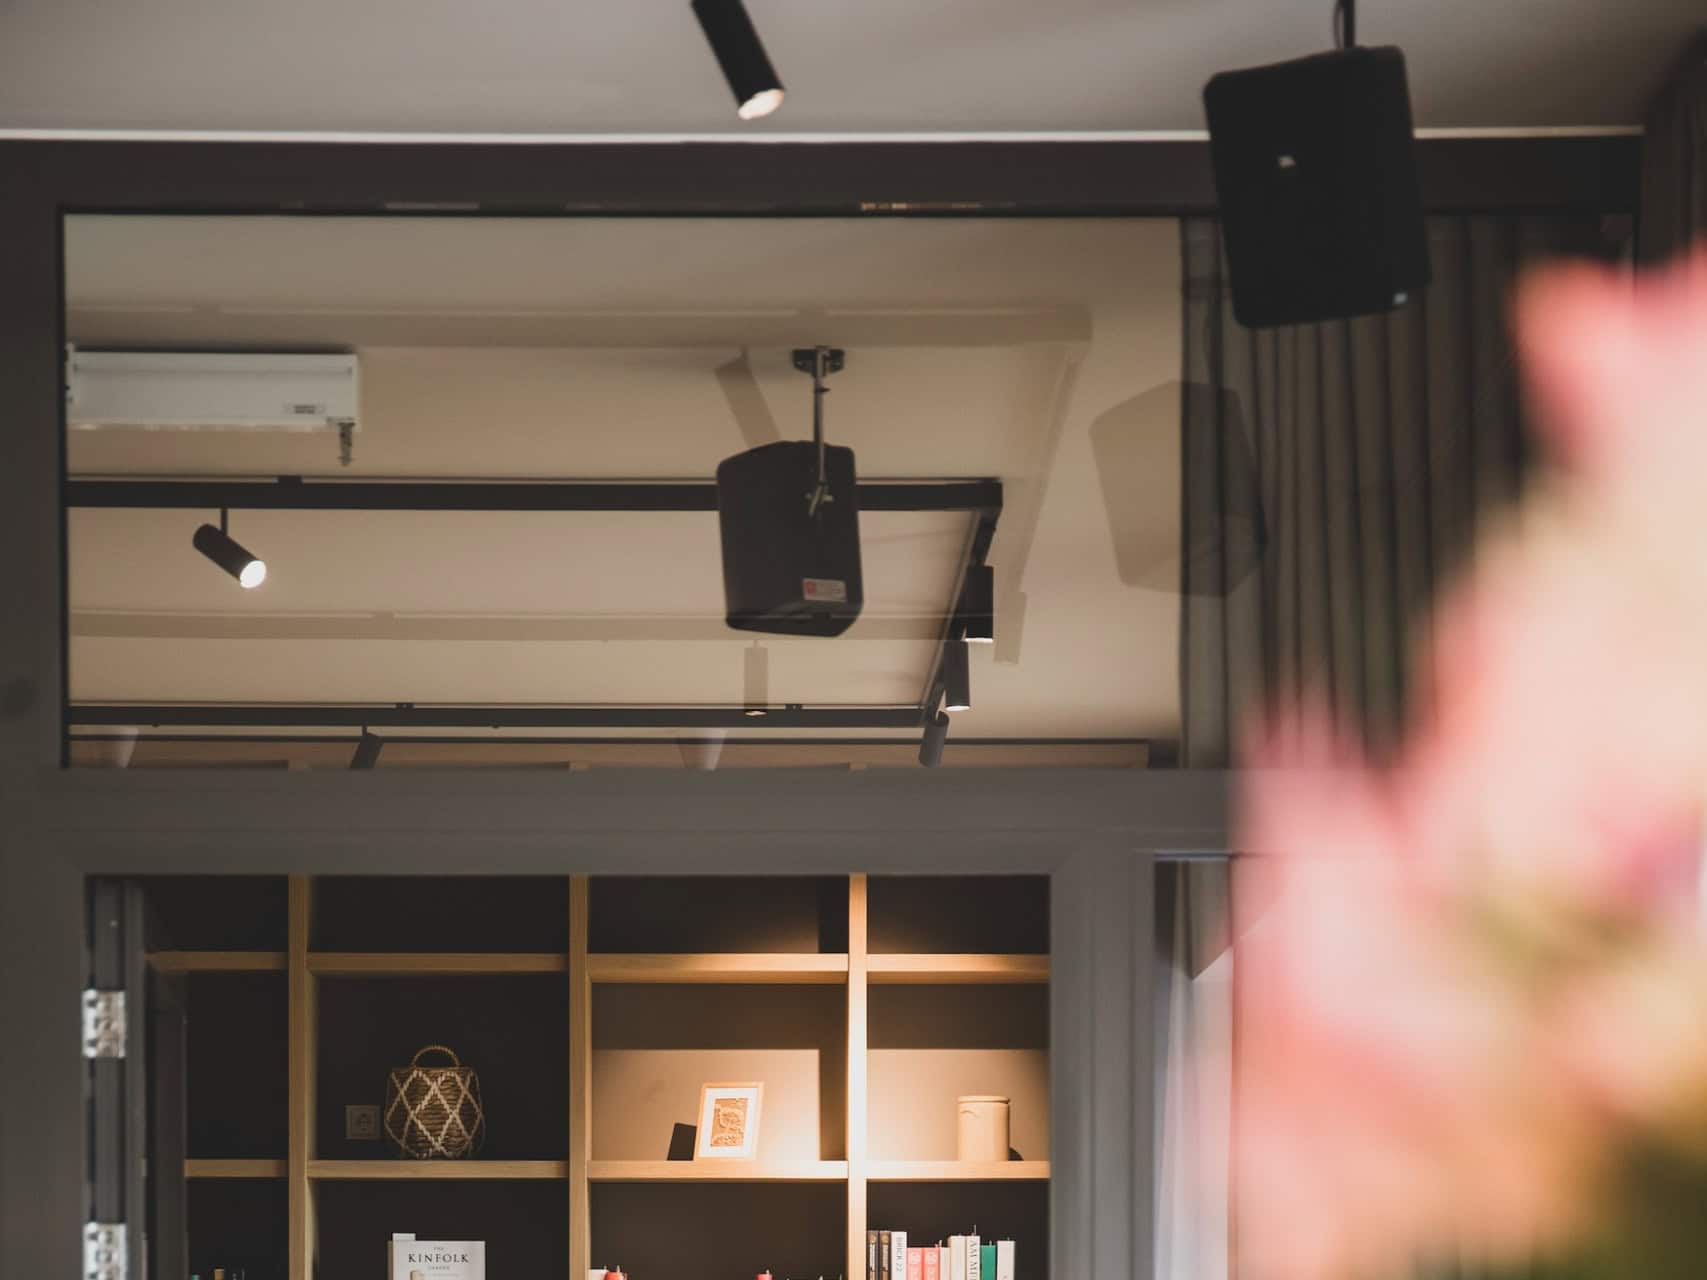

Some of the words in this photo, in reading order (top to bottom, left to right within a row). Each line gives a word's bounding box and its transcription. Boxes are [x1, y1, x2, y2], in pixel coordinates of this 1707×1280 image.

[969, 1240, 977, 1258] AM
[408, 1253, 470, 1263] KINFOLK
[895, 1262, 903, 1272] 22
